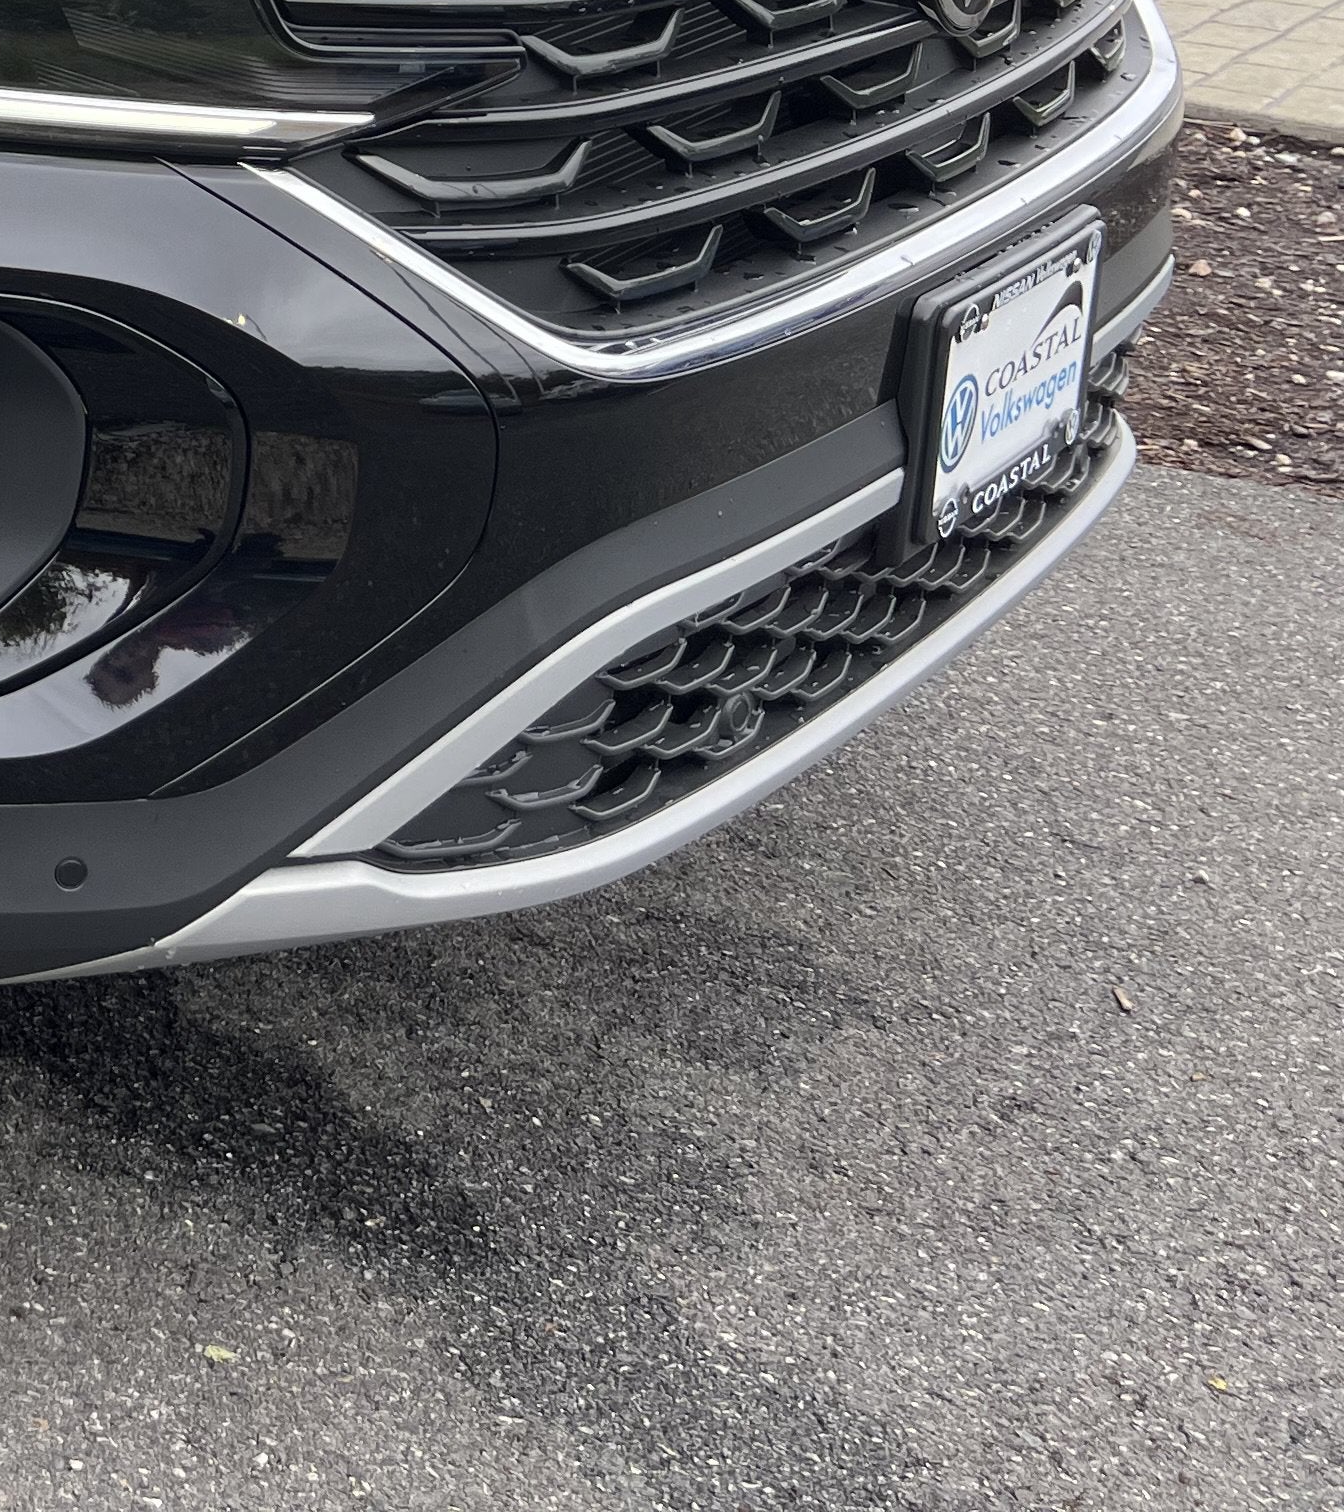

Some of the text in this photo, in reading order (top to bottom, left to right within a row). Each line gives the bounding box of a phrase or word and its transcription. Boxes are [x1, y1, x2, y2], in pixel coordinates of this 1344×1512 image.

[985, 317, 1082, 397] COASTAL
[980, 360, 1077, 445] Volkswagen
[972, 444, 1052, 514] COASTAL
